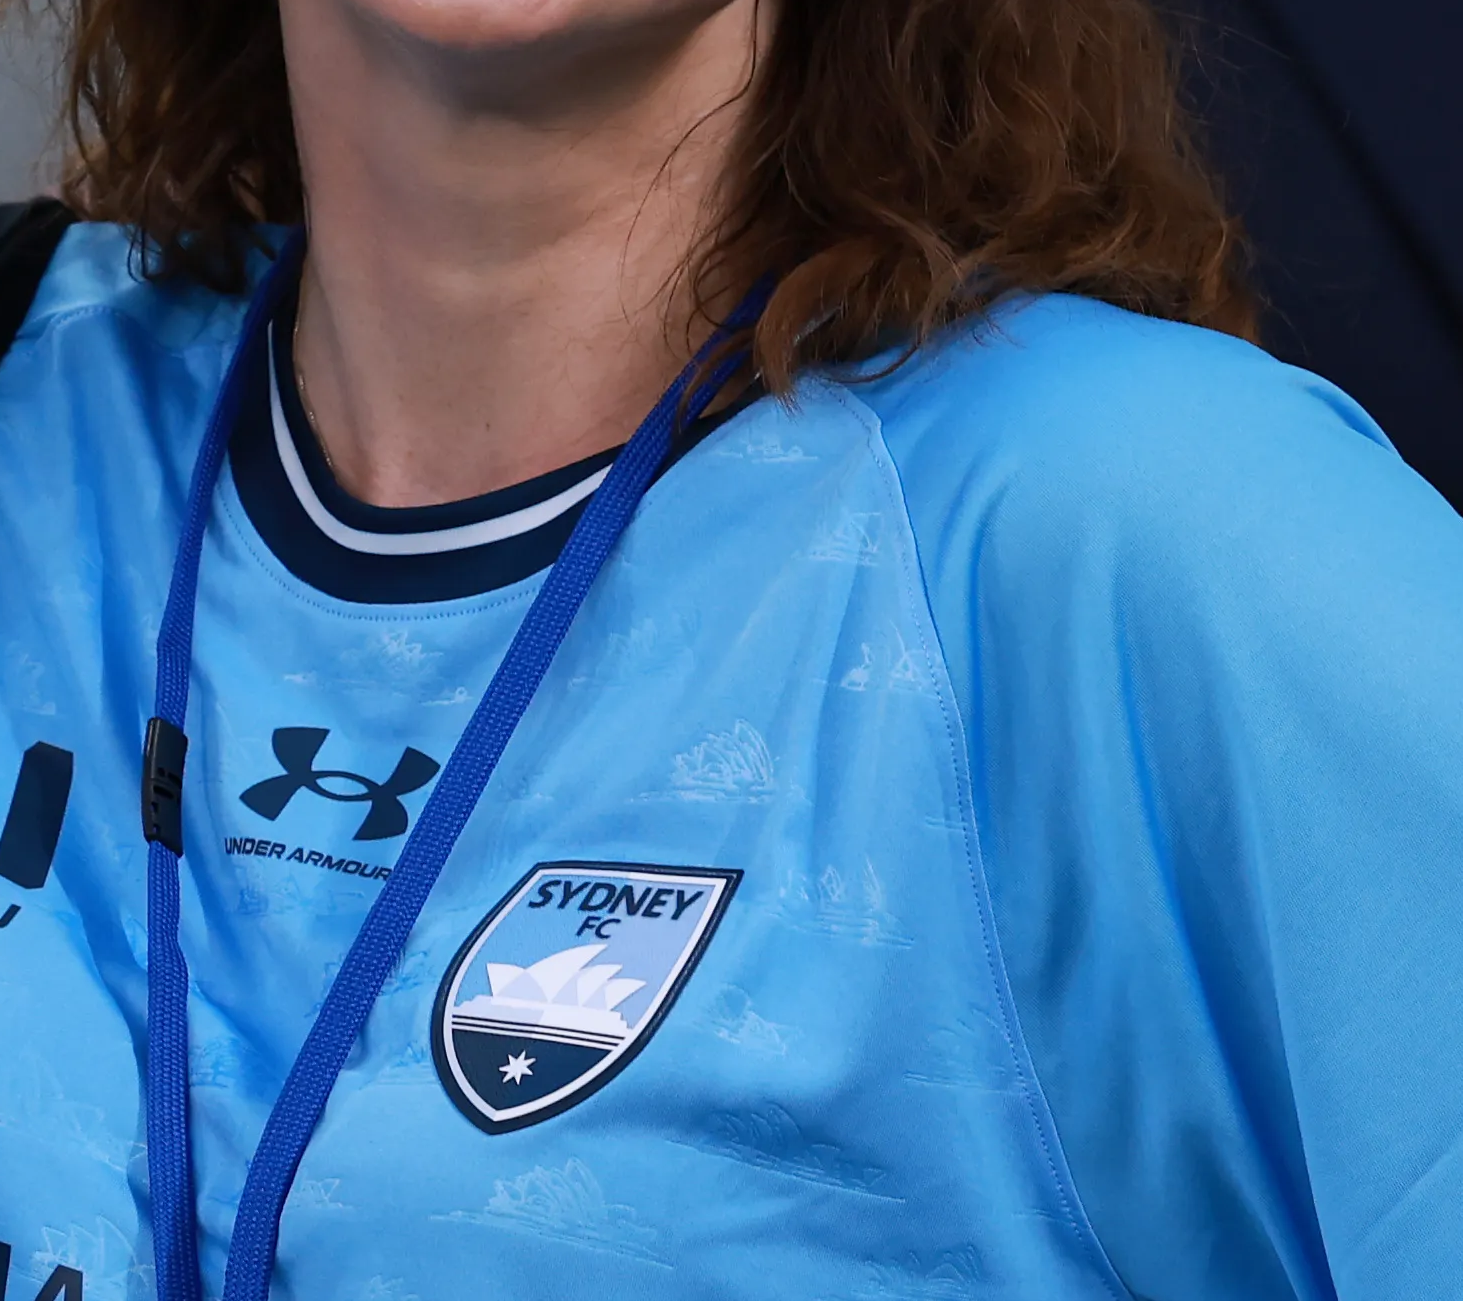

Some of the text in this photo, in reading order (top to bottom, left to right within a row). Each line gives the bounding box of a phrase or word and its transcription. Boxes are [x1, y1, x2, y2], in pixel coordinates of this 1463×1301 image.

[224, 836, 393, 882] UNDER ARMOUR
[527, 879, 704, 921] SYDNEY
[576, 915, 622, 939] FC
